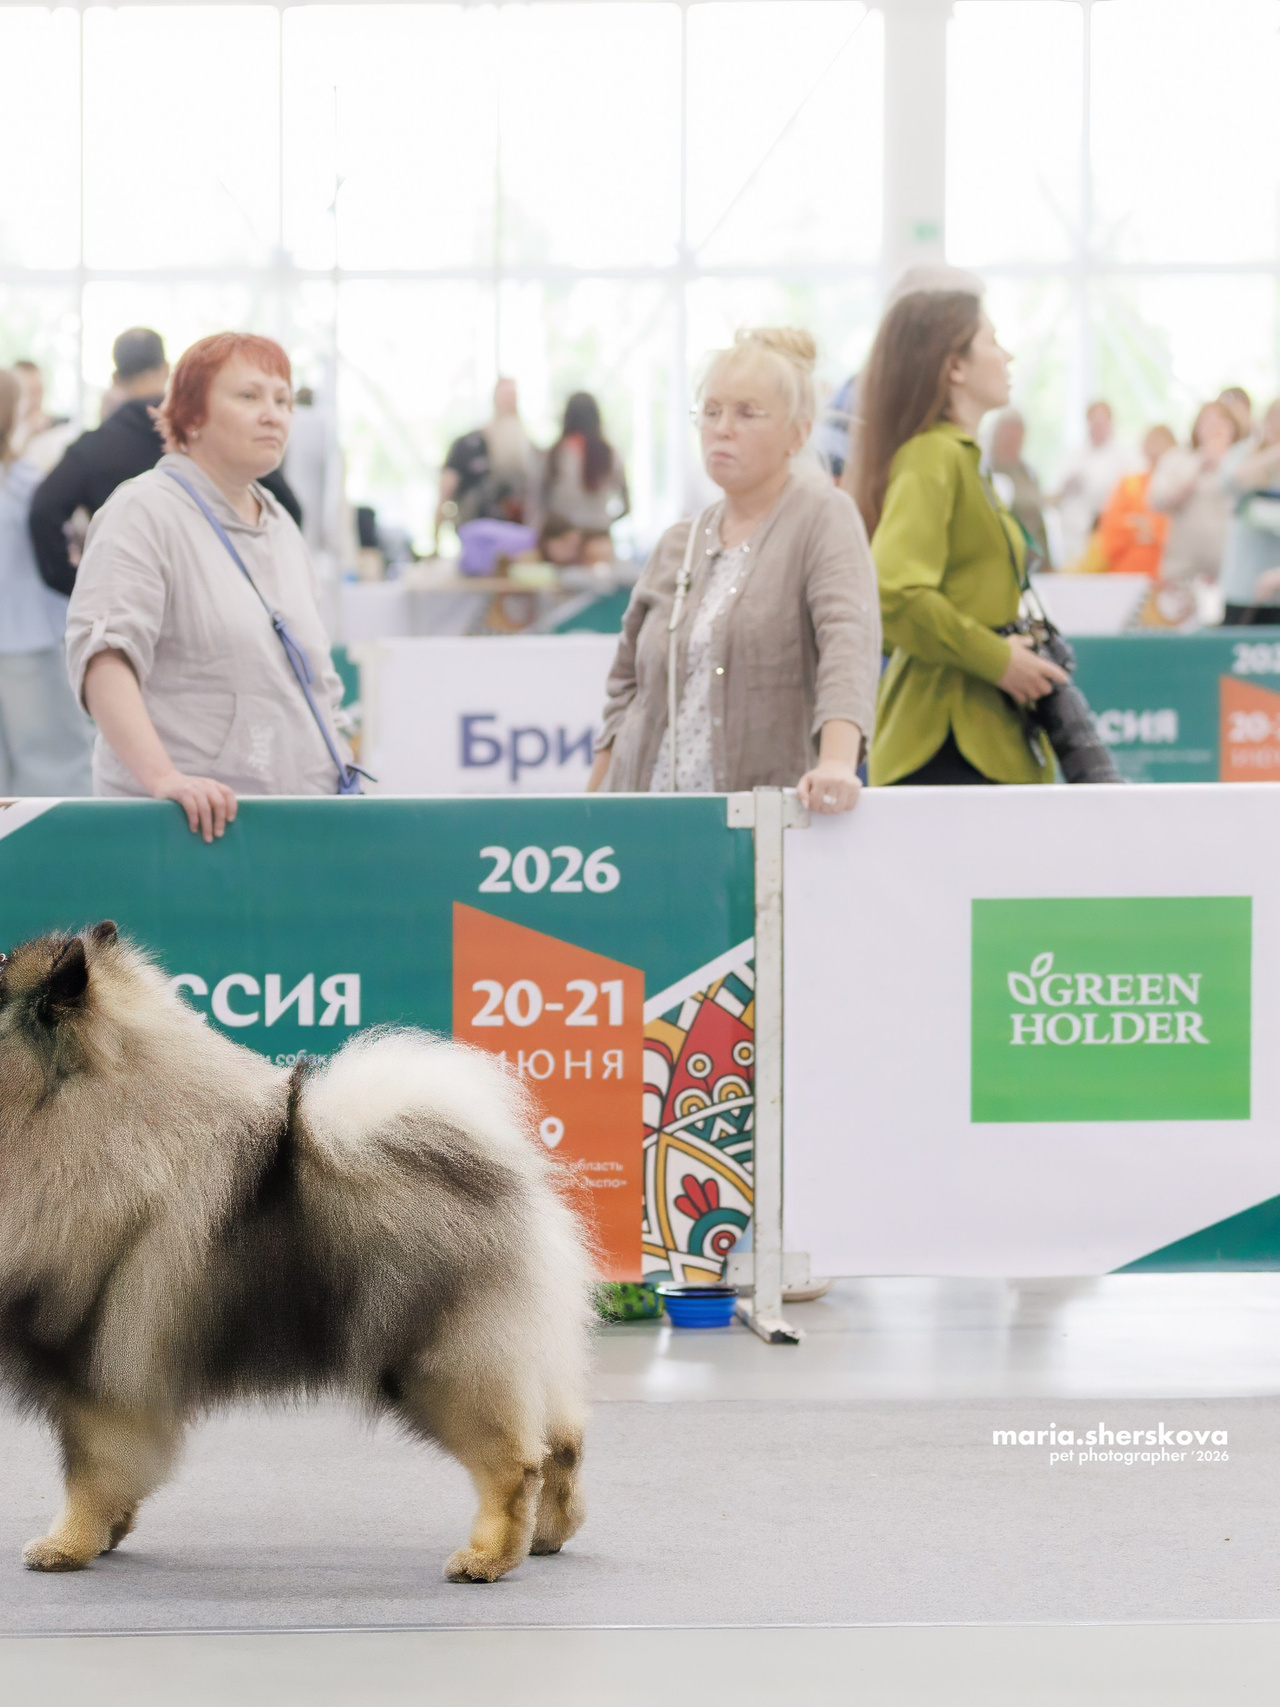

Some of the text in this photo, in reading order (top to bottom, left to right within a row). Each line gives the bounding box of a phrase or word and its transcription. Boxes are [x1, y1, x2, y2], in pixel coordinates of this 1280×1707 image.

[460, 713, 593, 783] Бри
[478, 845, 621, 893] 2026
[471, 979, 624, 1027] 20-21
[1040, 973, 1203, 1007] GREEN
[1009, 1011, 1210, 1045] HOLDER
